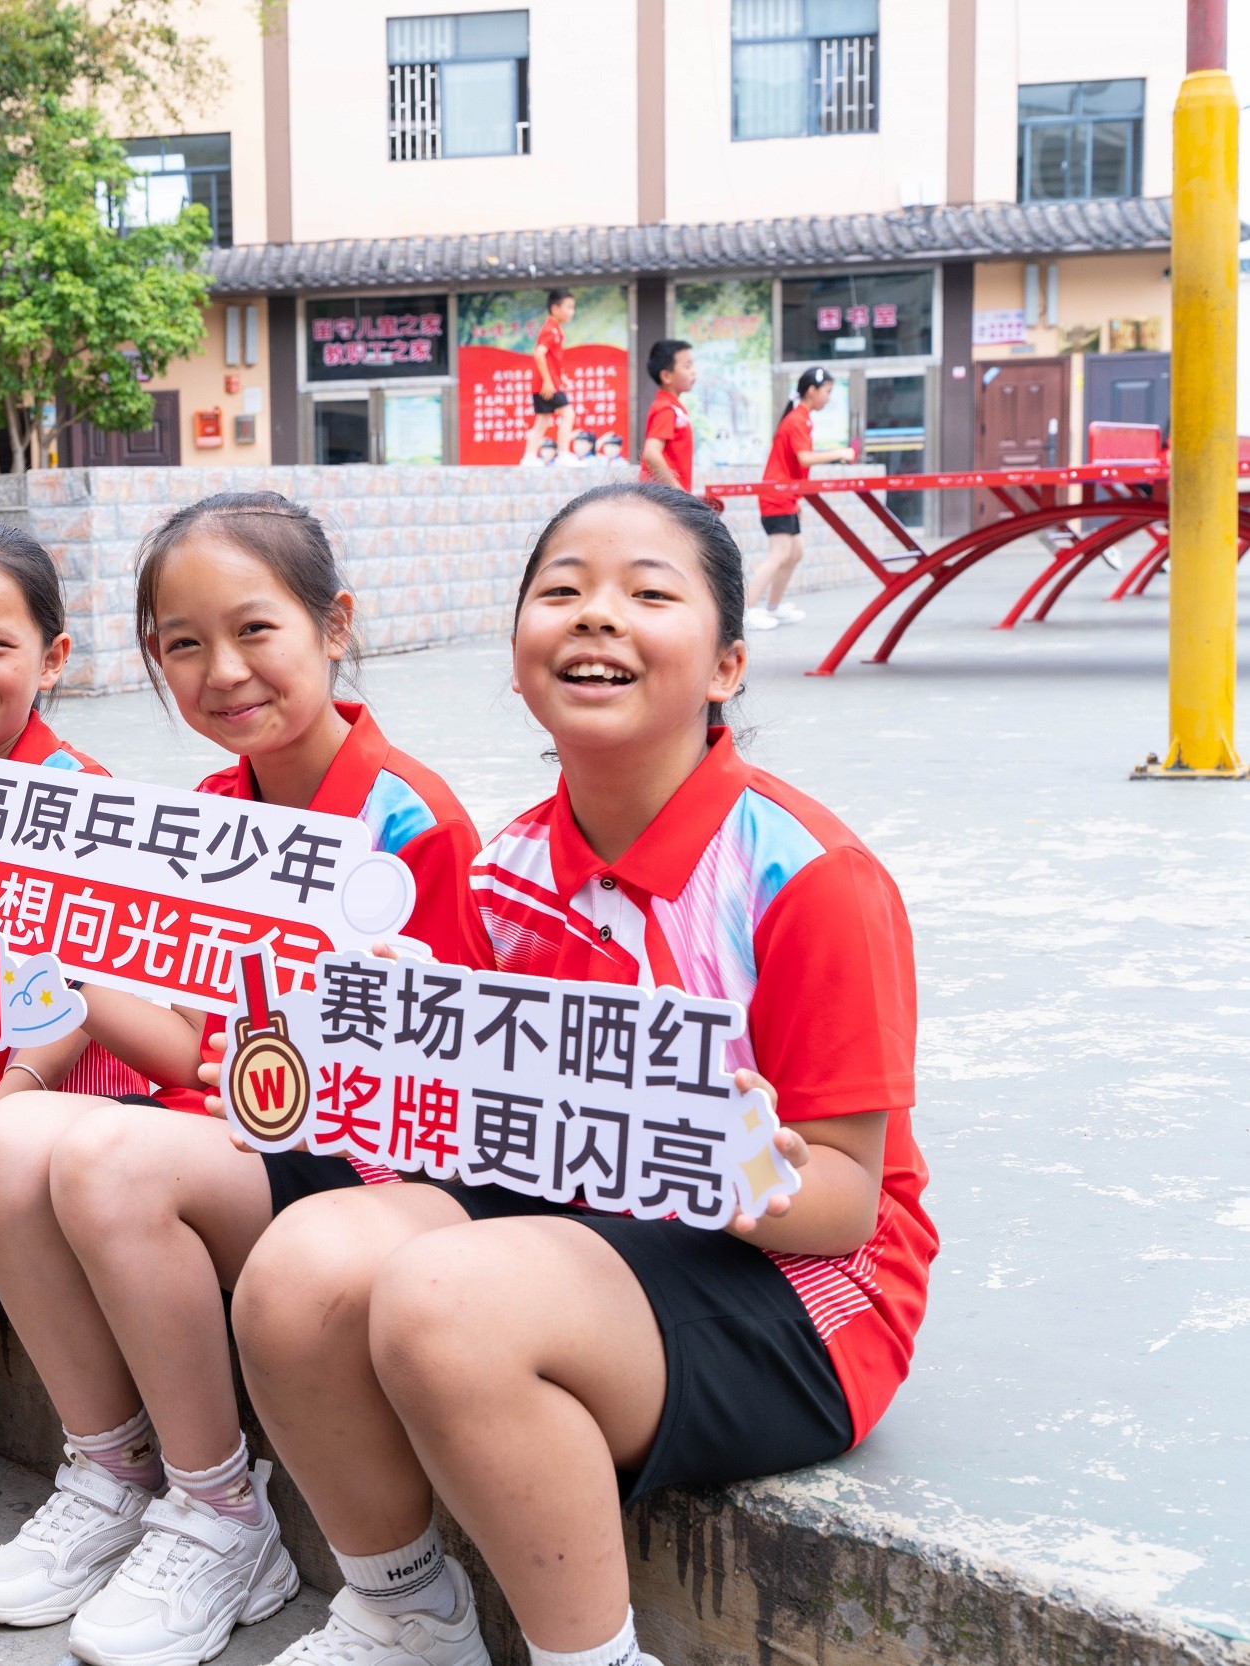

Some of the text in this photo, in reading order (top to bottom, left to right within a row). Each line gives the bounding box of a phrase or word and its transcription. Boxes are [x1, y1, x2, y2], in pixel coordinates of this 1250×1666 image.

[312, 313, 443, 341] 留守儿童之家
[321, 961, 731, 1099] 赛场不晒红
[248, 1065, 287, 1113] W
[315, 1062, 727, 1217] 奖牌更闪亮
